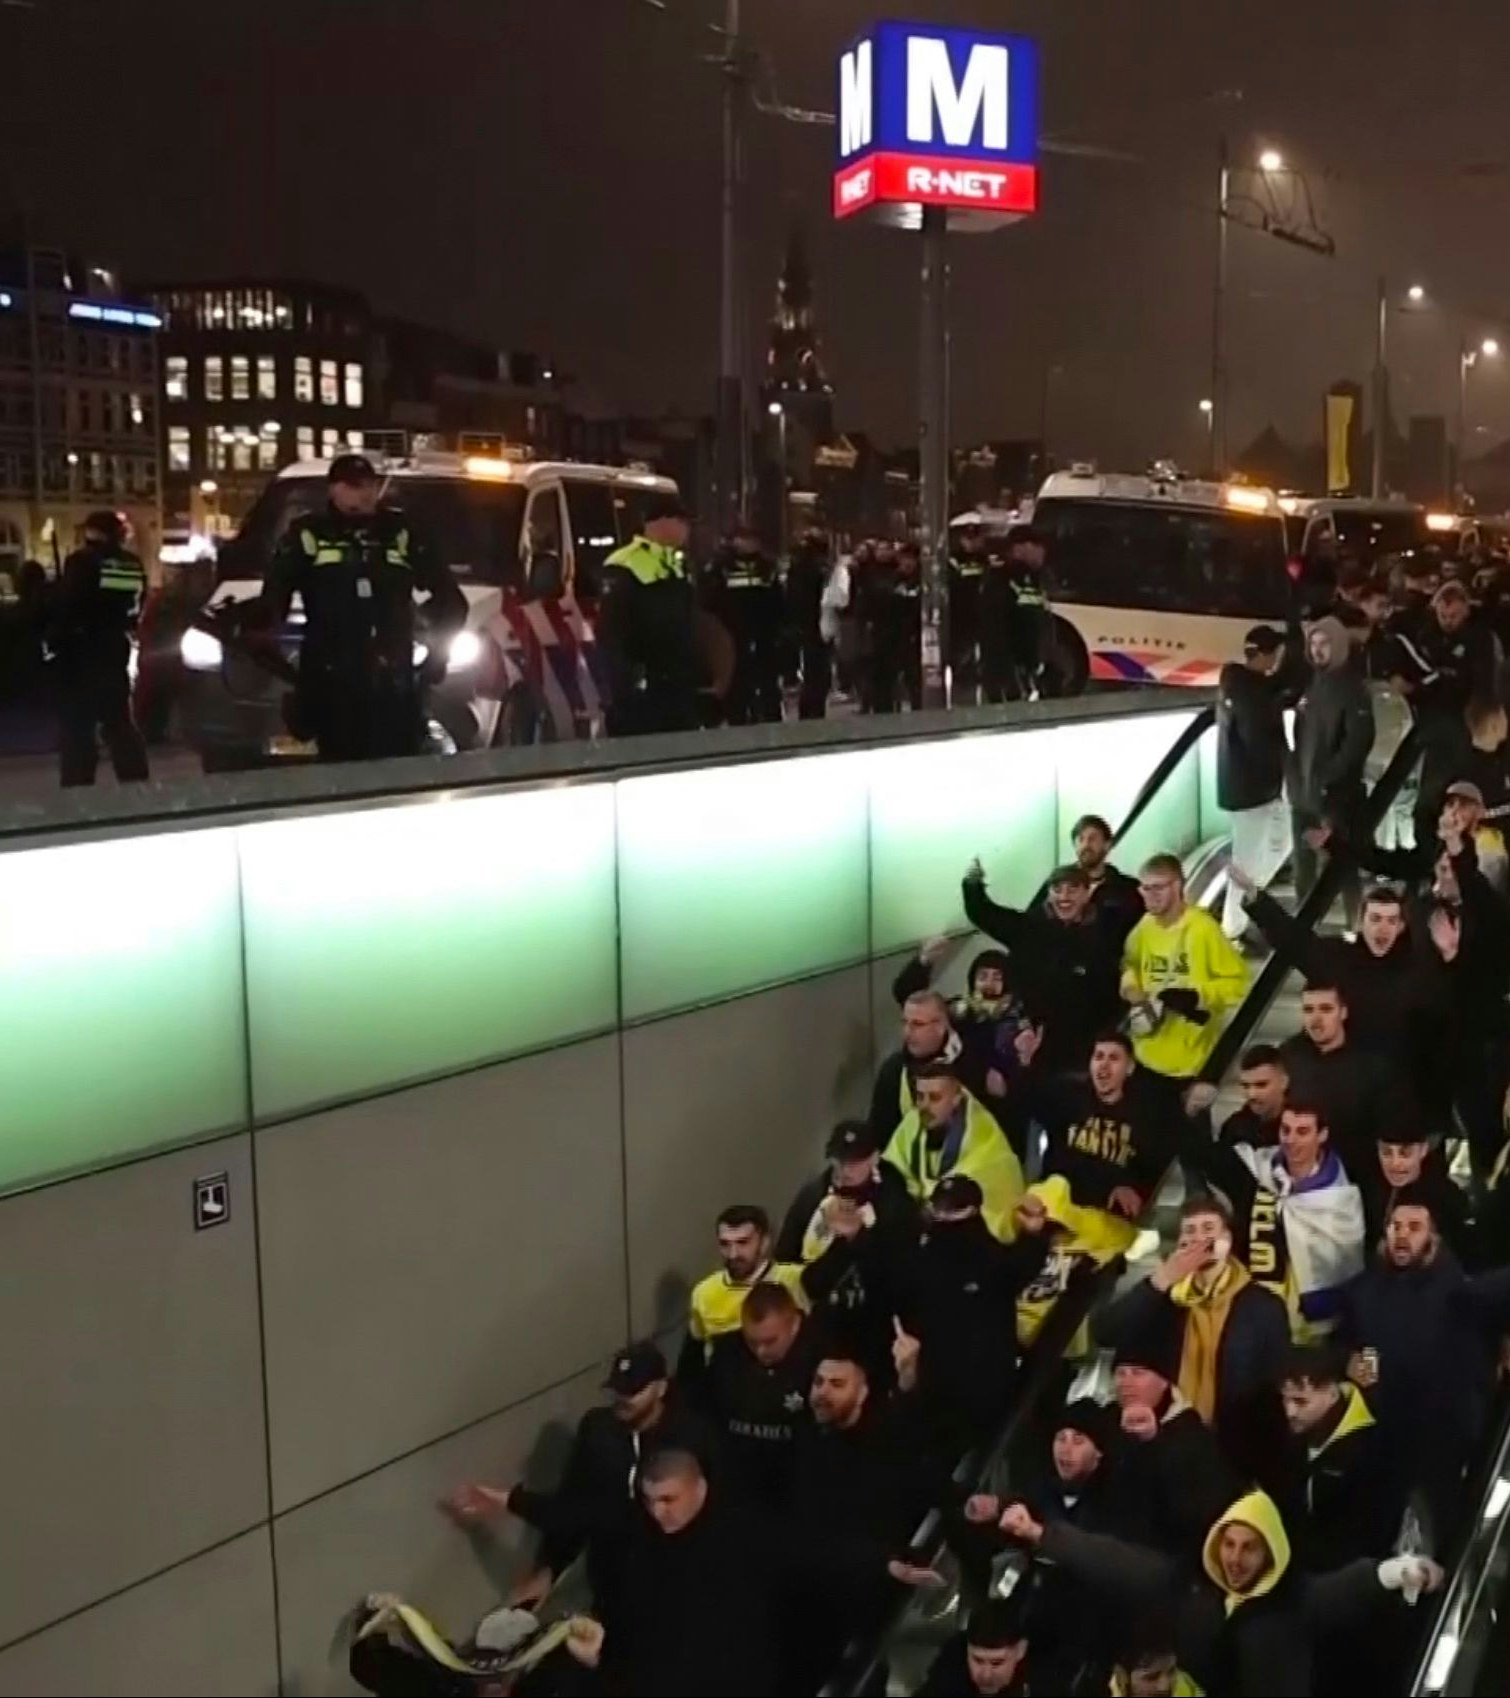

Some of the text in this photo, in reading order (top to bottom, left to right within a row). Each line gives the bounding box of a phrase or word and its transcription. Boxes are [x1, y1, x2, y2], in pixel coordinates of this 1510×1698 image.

[841, 39, 872, 157] M
[907, 36, 1008, 149] M
[1098, 635, 1186, 651] POLITIE
